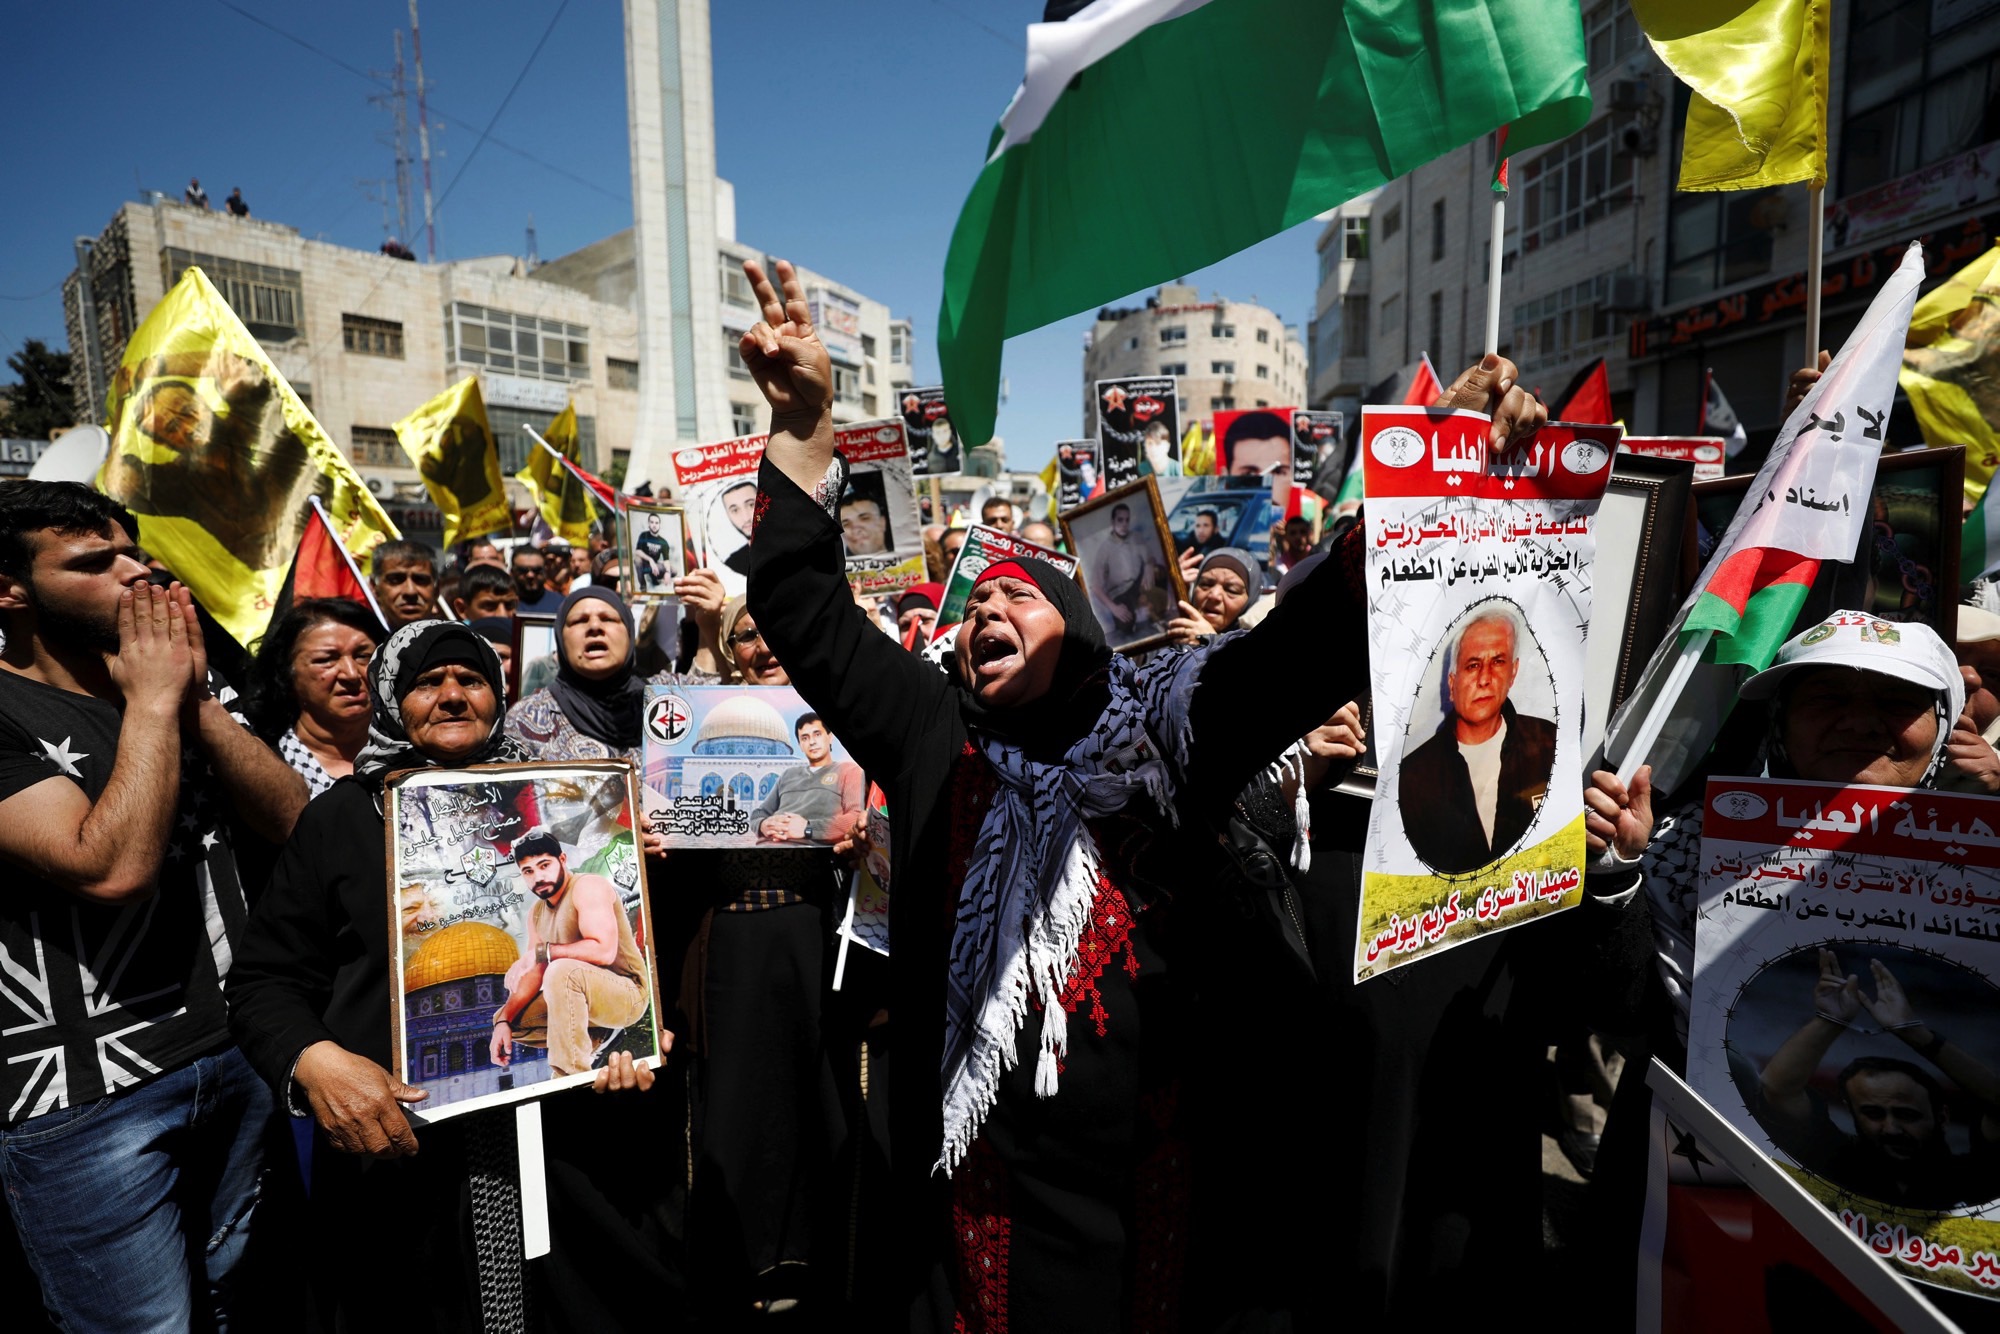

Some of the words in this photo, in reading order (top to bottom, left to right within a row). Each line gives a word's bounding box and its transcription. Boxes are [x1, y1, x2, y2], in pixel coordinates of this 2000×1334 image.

[1856, 405, 1885, 441] لا
[703, 443, 733, 463] العليا
[1786, 486, 1850, 517] إسناد
[1376, 513, 1467, 549] والمحررين
[1501, 512, 1532, 543] شؤون
[1535, 513, 1588, 543] لمتابعة
[1381, 554, 1443, 589] الطعام
[1447, 557, 1467, 586] عن
[1529, 548, 1579, 579] الحرية
[1836, 616, 1867, 626] 12
[430, 796, 461, 822] البطل
[465, 783, 503, 812] الأسير
[446, 821, 481, 847] خليل
[481, 814, 522, 842] مصباح
[1776, 796, 1879, 841] العليا
[1890, 799, 2000, 857] هيئة
[1539, 868, 1580, 902] عميد
[1709, 852, 1829, 889] والمحررين
[1832, 870, 1925, 897] الأسرى
[1478, 872, 1536, 919] الأسرى
[1722, 886, 1790, 913] الطعام
[1795, 897, 1830, 921] عن
[1836, 906, 1916, 932] المضرب
[1366, 915, 1419, 963] يونس
[1871, 1222, 1961, 1270] مروان
